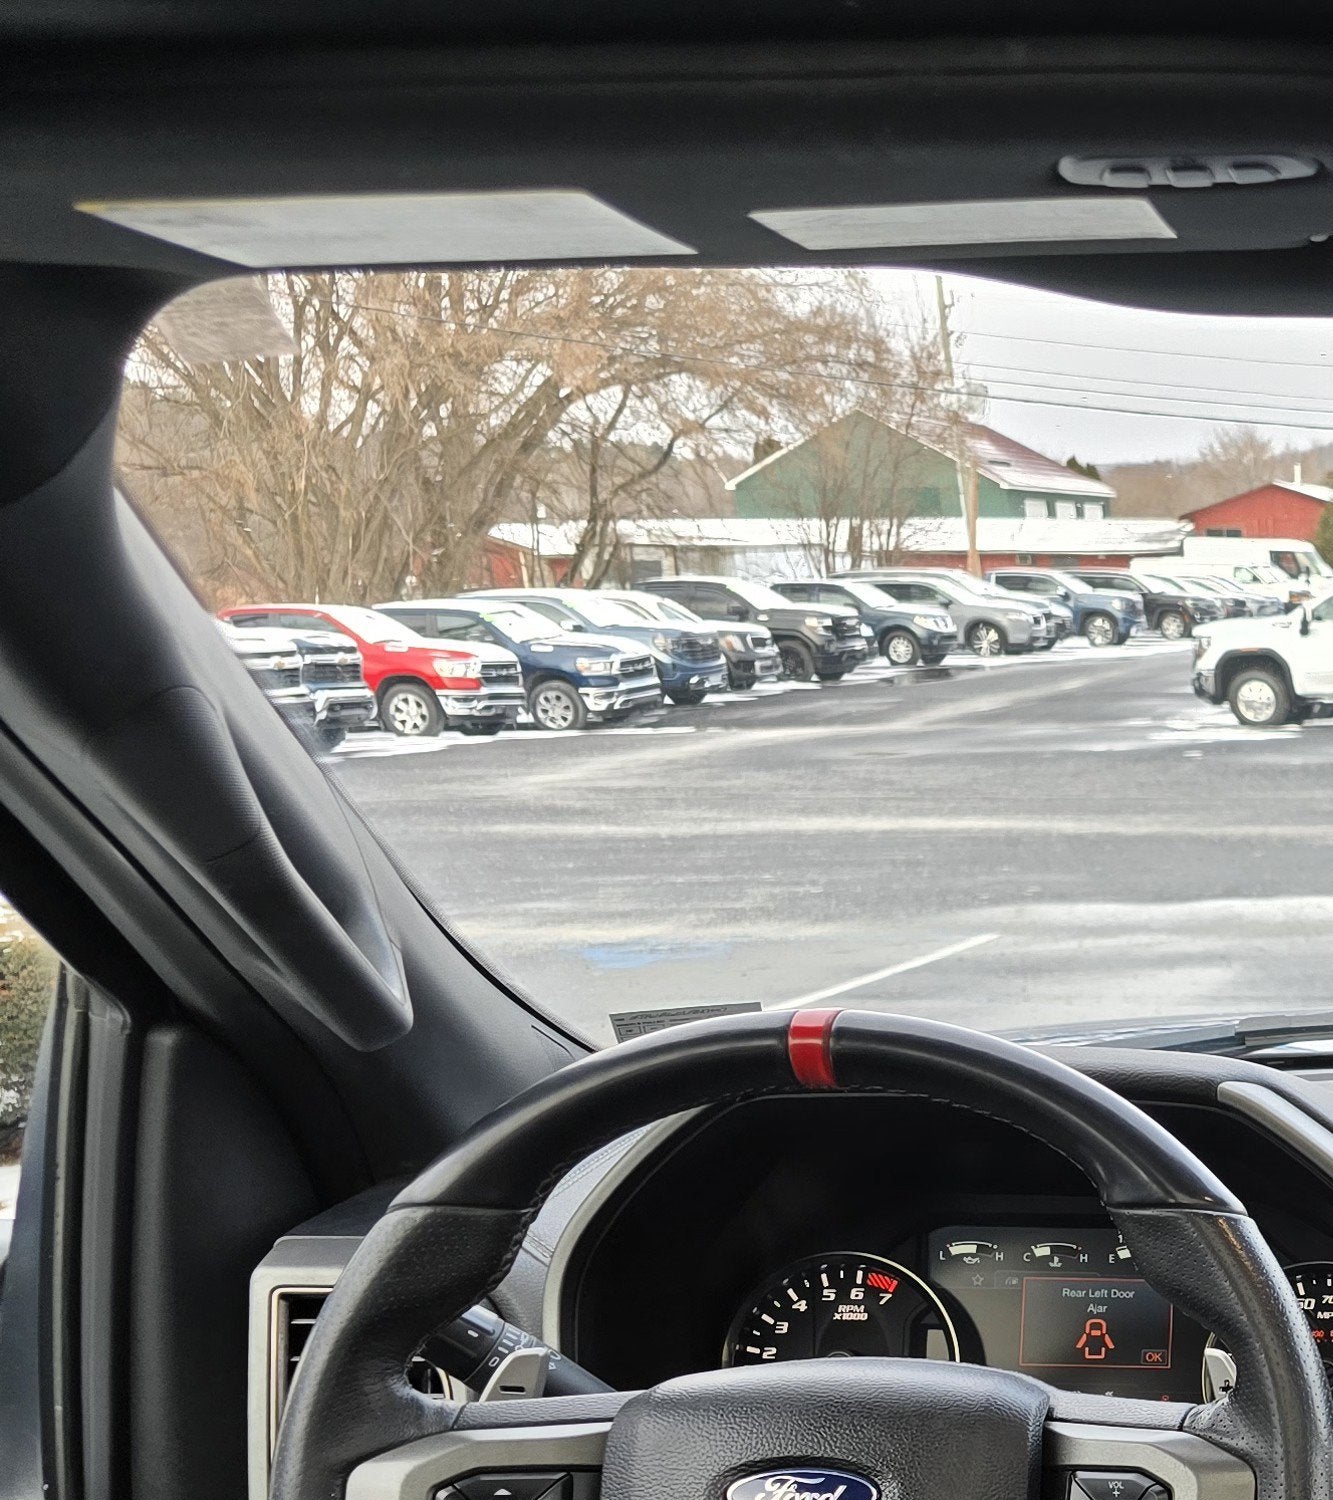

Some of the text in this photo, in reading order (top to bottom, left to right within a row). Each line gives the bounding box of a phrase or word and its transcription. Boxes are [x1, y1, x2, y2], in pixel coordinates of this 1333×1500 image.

[821, 1289, 837, 1301] 5
[850, 1288, 864, 1300] 6
[879, 1293, 892, 1305] 7
[1062, 1288, 1135, 1299] Rear Left Door
[792, 1300, 807, 1312] 4
[837, 1304, 865, 1313] RPM
[1087, 1303, 1108, 1315] Ajar
[775, 1322, 789, 1334] 3
[762, 1347, 777, 1360] 2
[1145, 1352, 1163, 1362] OK
[1108, 1481, 1124, 1489] VOL
